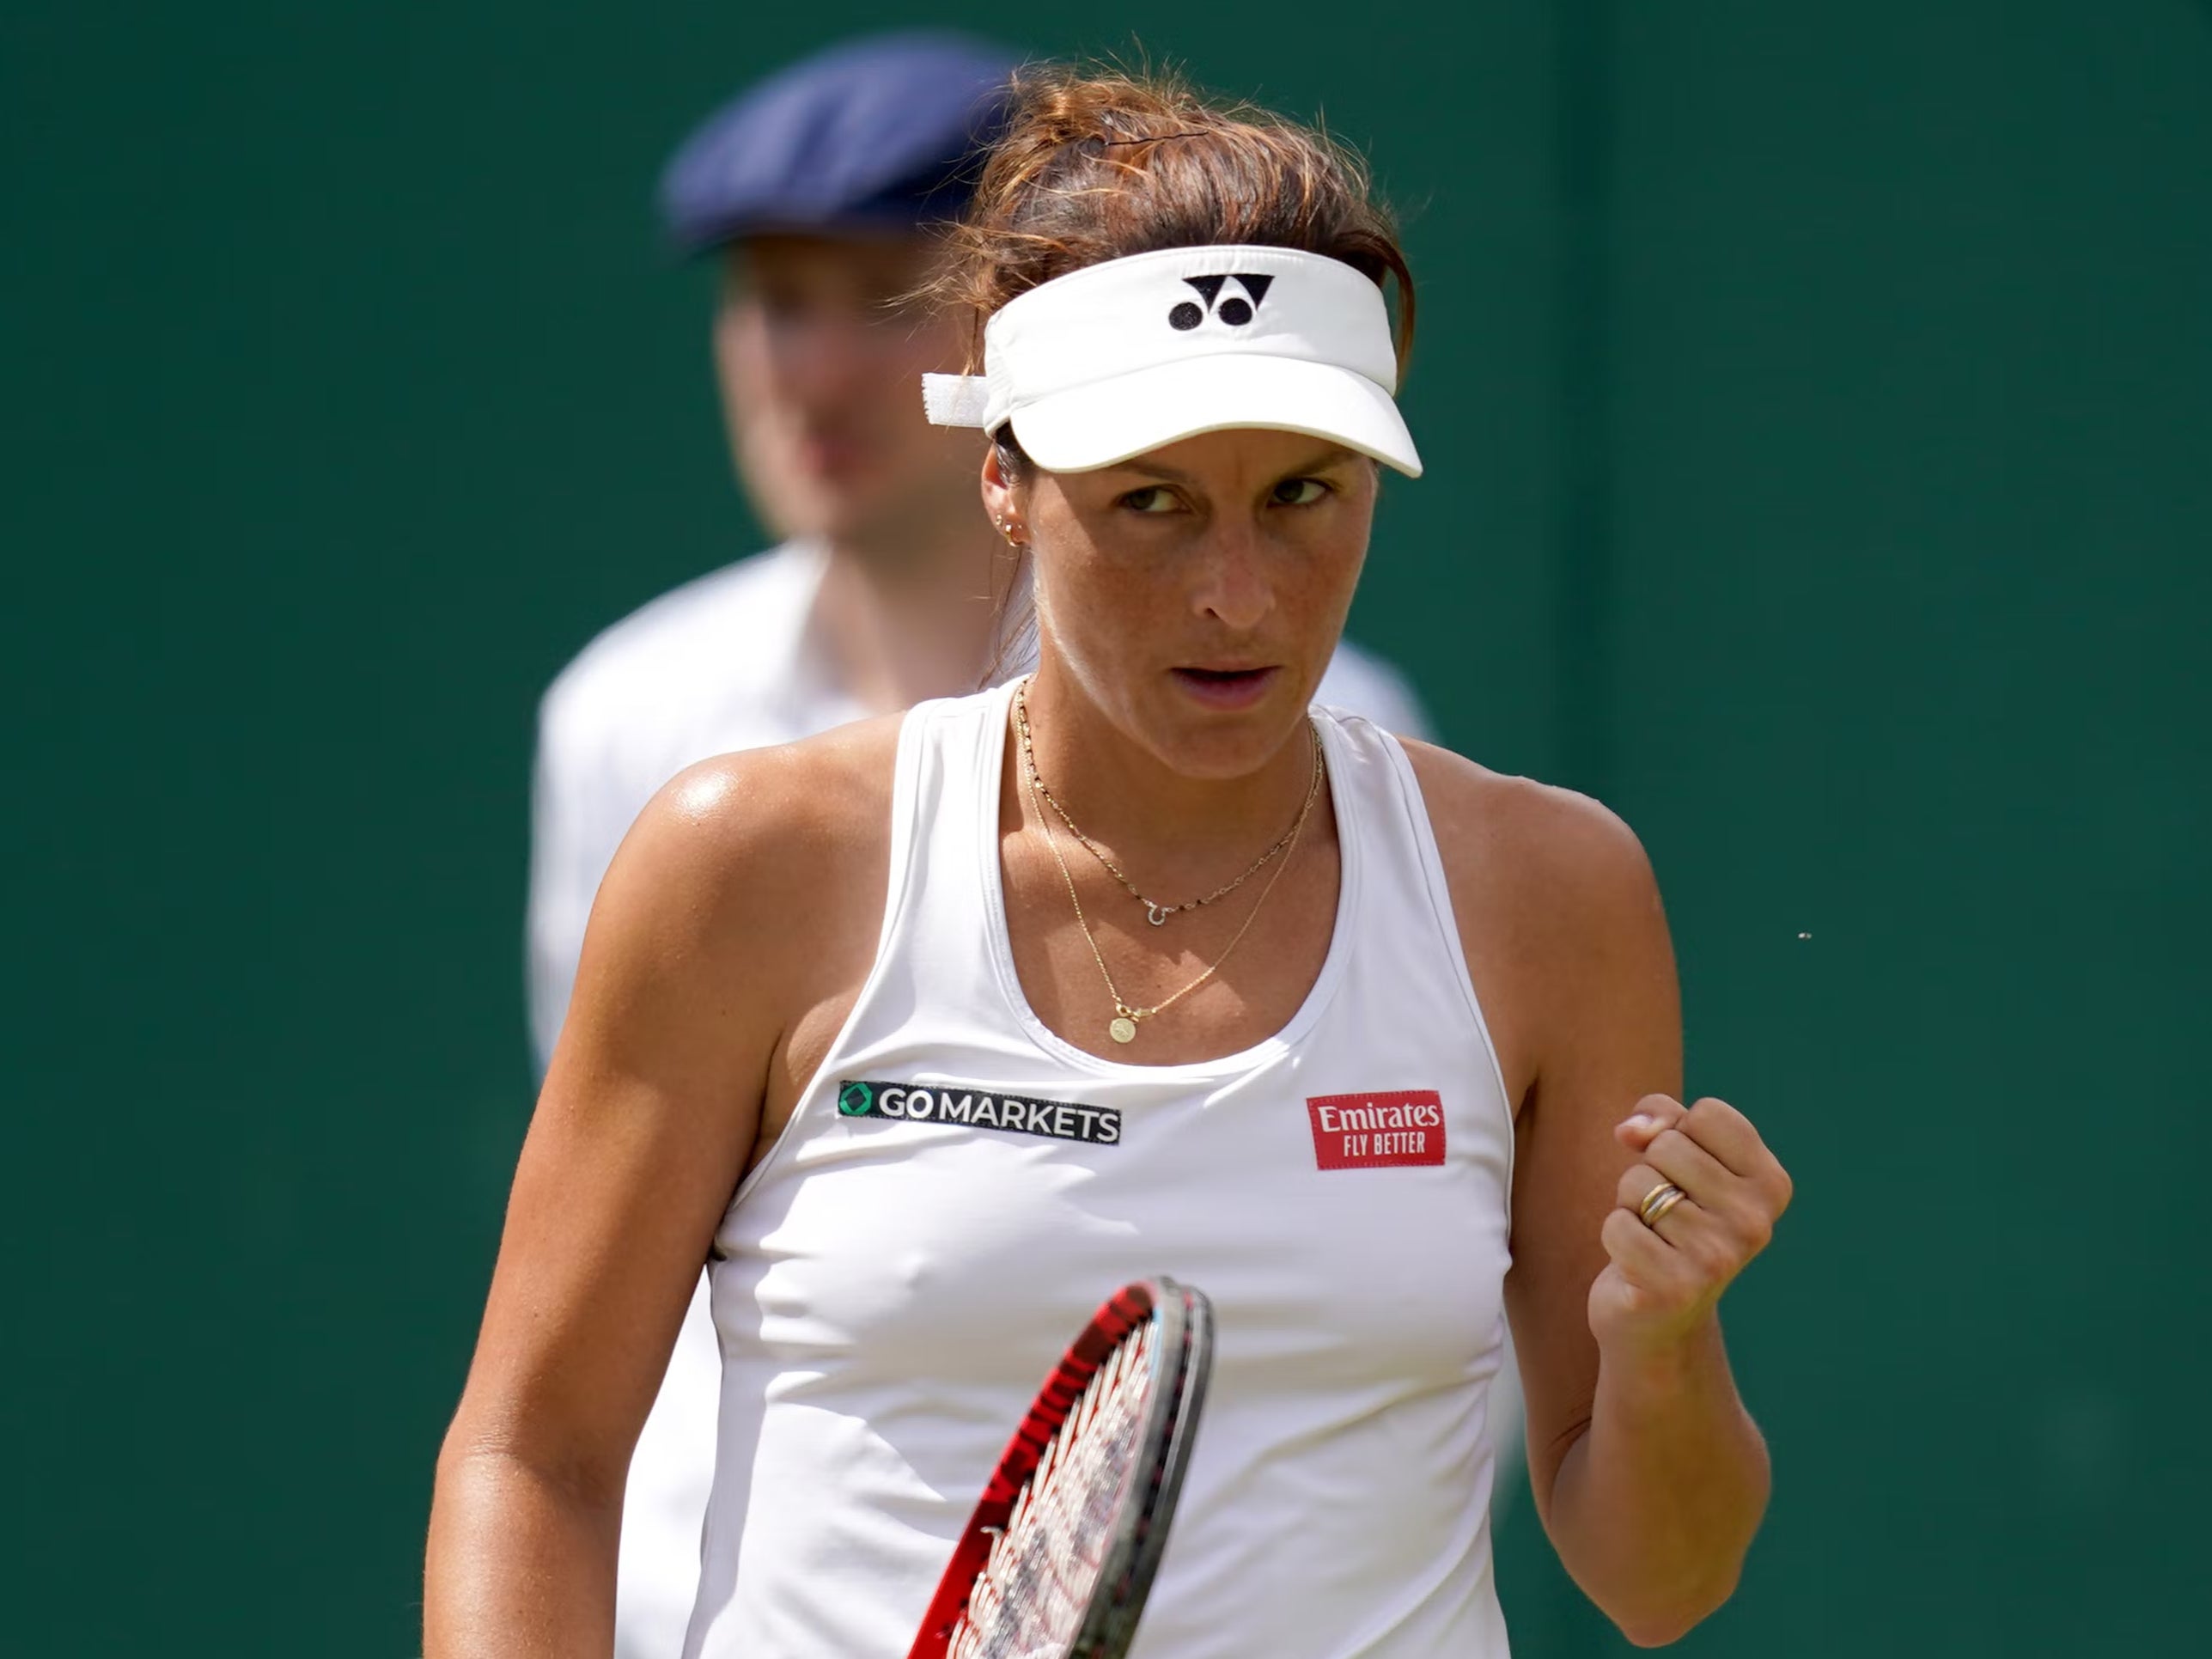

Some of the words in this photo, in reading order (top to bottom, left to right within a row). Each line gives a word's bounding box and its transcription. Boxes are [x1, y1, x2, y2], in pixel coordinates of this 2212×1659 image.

[878, 1088, 935, 1119] GO
[940, 1092, 1119, 1143] MARKETS
[1318, 1102, 1440, 1132] Emirates
[1344, 1135, 1368, 1156] FLY
[1374, 1131, 1426, 1156] BETTER
